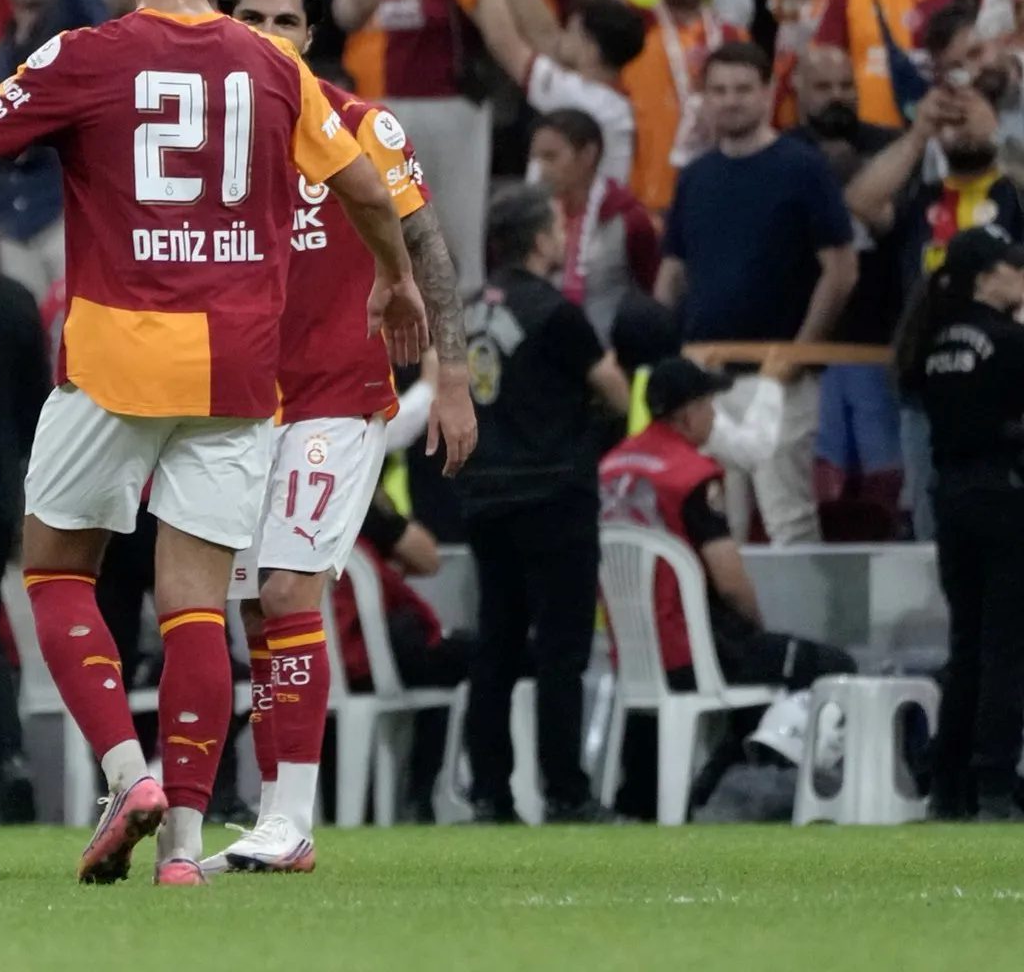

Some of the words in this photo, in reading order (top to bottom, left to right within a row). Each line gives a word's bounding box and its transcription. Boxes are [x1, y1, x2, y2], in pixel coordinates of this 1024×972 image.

[134, 70, 254, 206] 21
[213, 221, 265, 262] GÜL
[285, 469, 336, 521] 17
